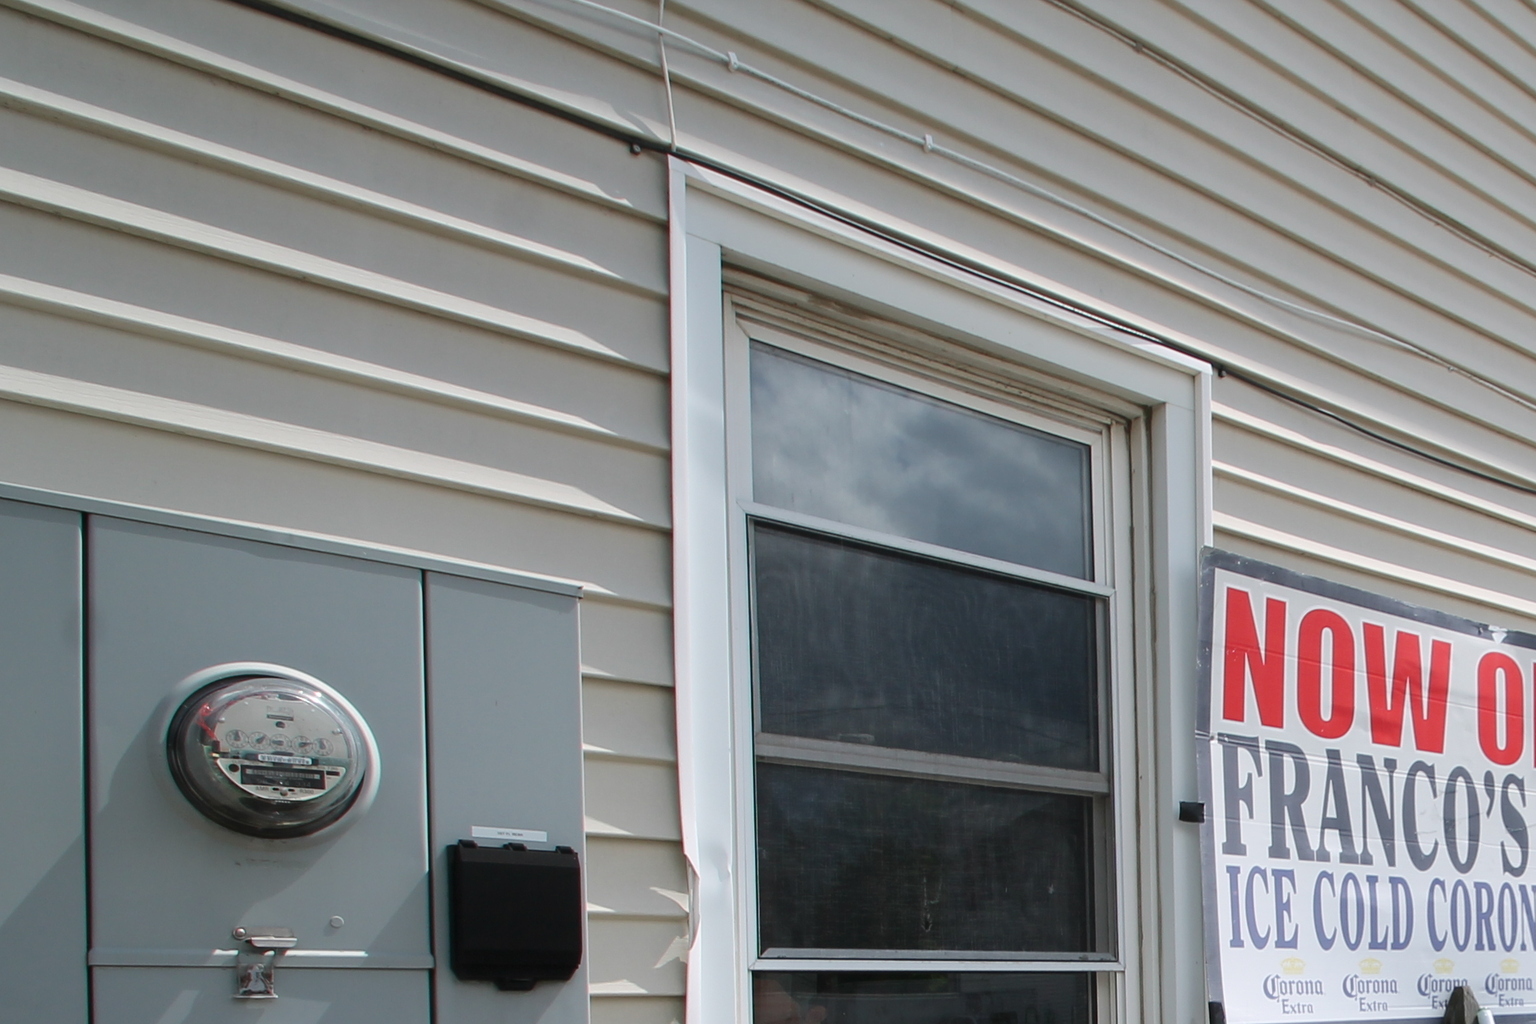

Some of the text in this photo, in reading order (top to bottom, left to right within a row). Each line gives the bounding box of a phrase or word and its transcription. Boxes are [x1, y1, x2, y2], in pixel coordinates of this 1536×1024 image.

[1222, 586, 1452, 754] NOW
[1217, 732, 1529, 879] FRANCO'S
[1226, 865, 1299, 950] ICE
[1313, 870, 1414, 952] COLD
[1263, 973, 1324, 1002] Corona
[1343, 973, 1398, 1001] Corona
[1485, 973, 1533, 997] Corona
[1282, 999, 1314, 1014] Extra
[1359, 997, 1388, 1012] Extra
[1432, 996, 1448, 1010] Ext
[1499, 994, 1524, 1007] Extra
